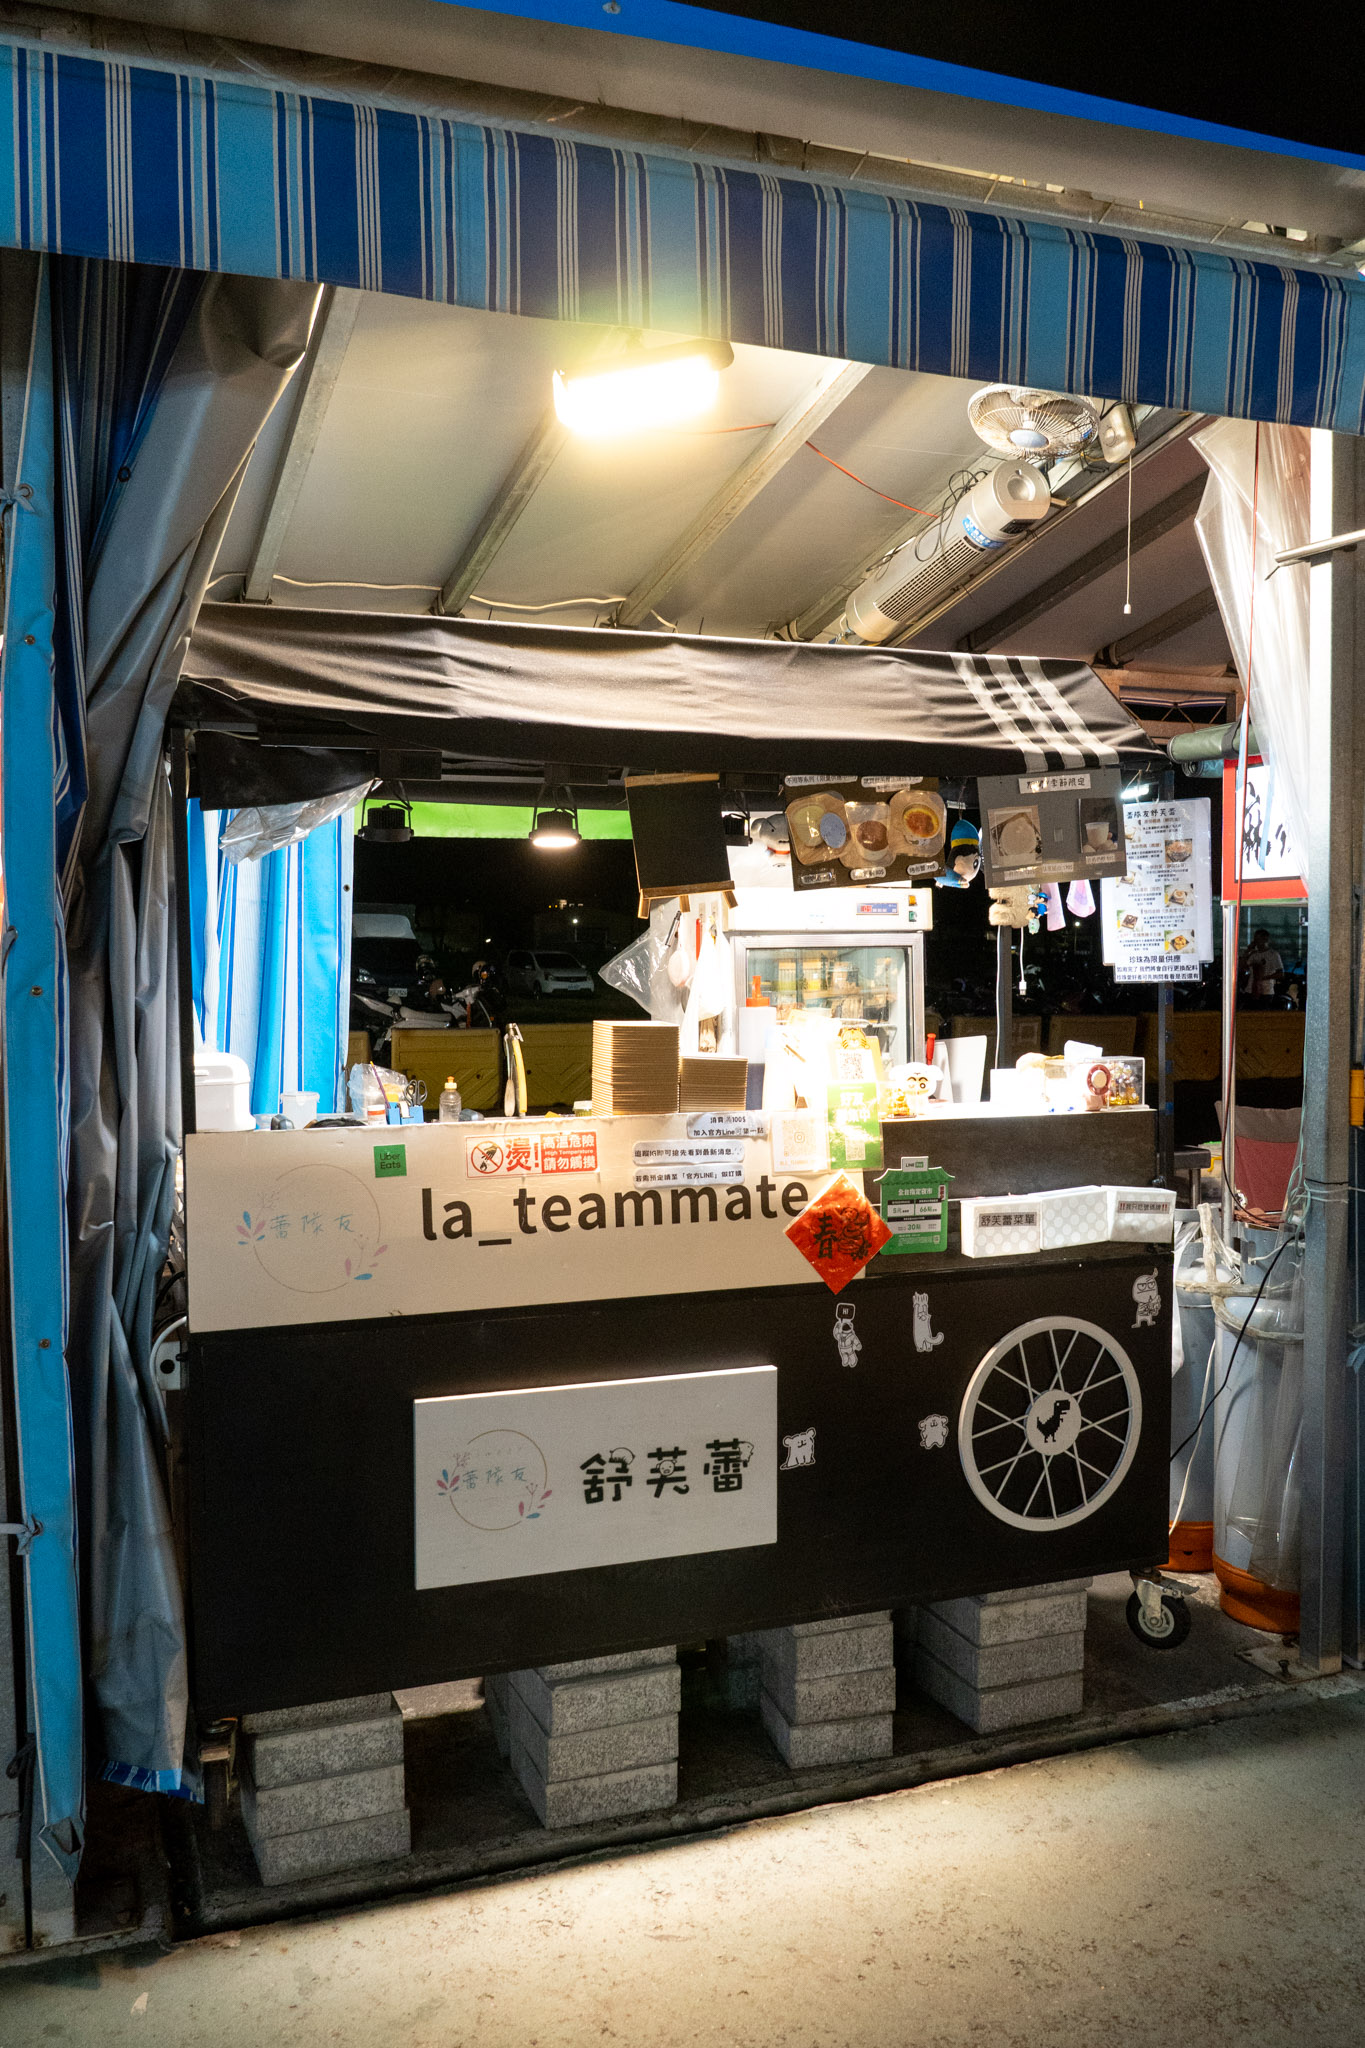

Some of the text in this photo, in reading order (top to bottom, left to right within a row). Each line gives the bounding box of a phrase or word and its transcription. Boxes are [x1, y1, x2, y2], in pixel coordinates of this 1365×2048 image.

[1129, 955, 1181, 963] 珍珠為限量供應
[543, 1134, 594, 1148] 高溫危險
[543, 1155, 595, 1171] 請勿觸摸
[421, 1175, 809, 1247] la_teammate
[980, 1214, 1035, 1226] 舒芙蕾菜單
[580, 1438, 752, 1504] 舒芙蕾
